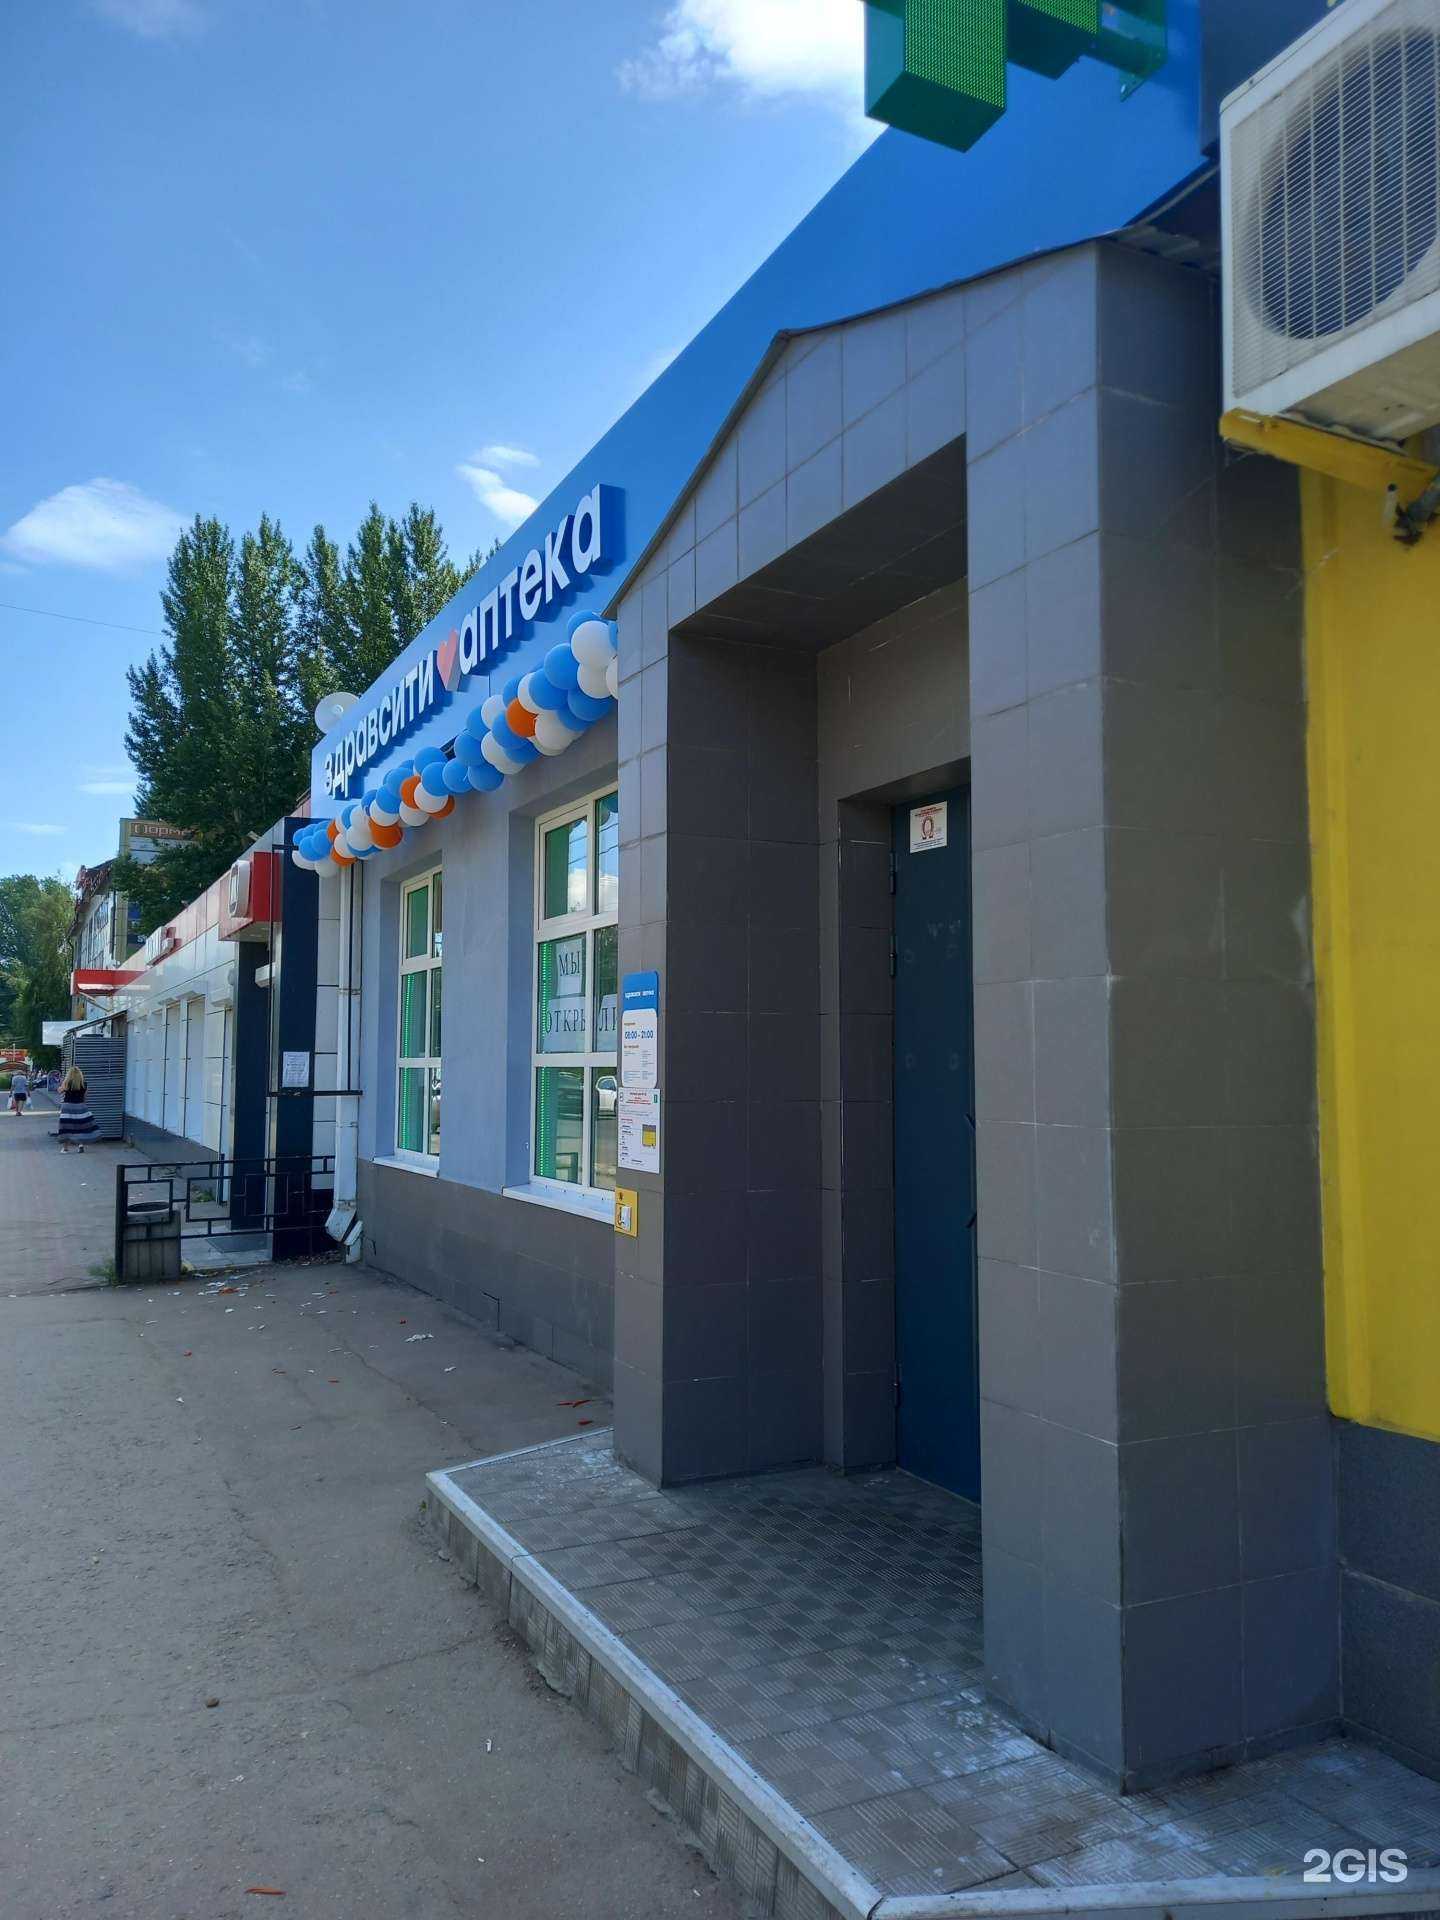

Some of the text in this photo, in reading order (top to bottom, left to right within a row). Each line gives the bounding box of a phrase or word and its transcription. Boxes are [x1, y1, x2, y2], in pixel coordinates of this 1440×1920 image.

[323, 483, 602, 800] здравсити аптека
[558, 951, 581, 976] МЫ
